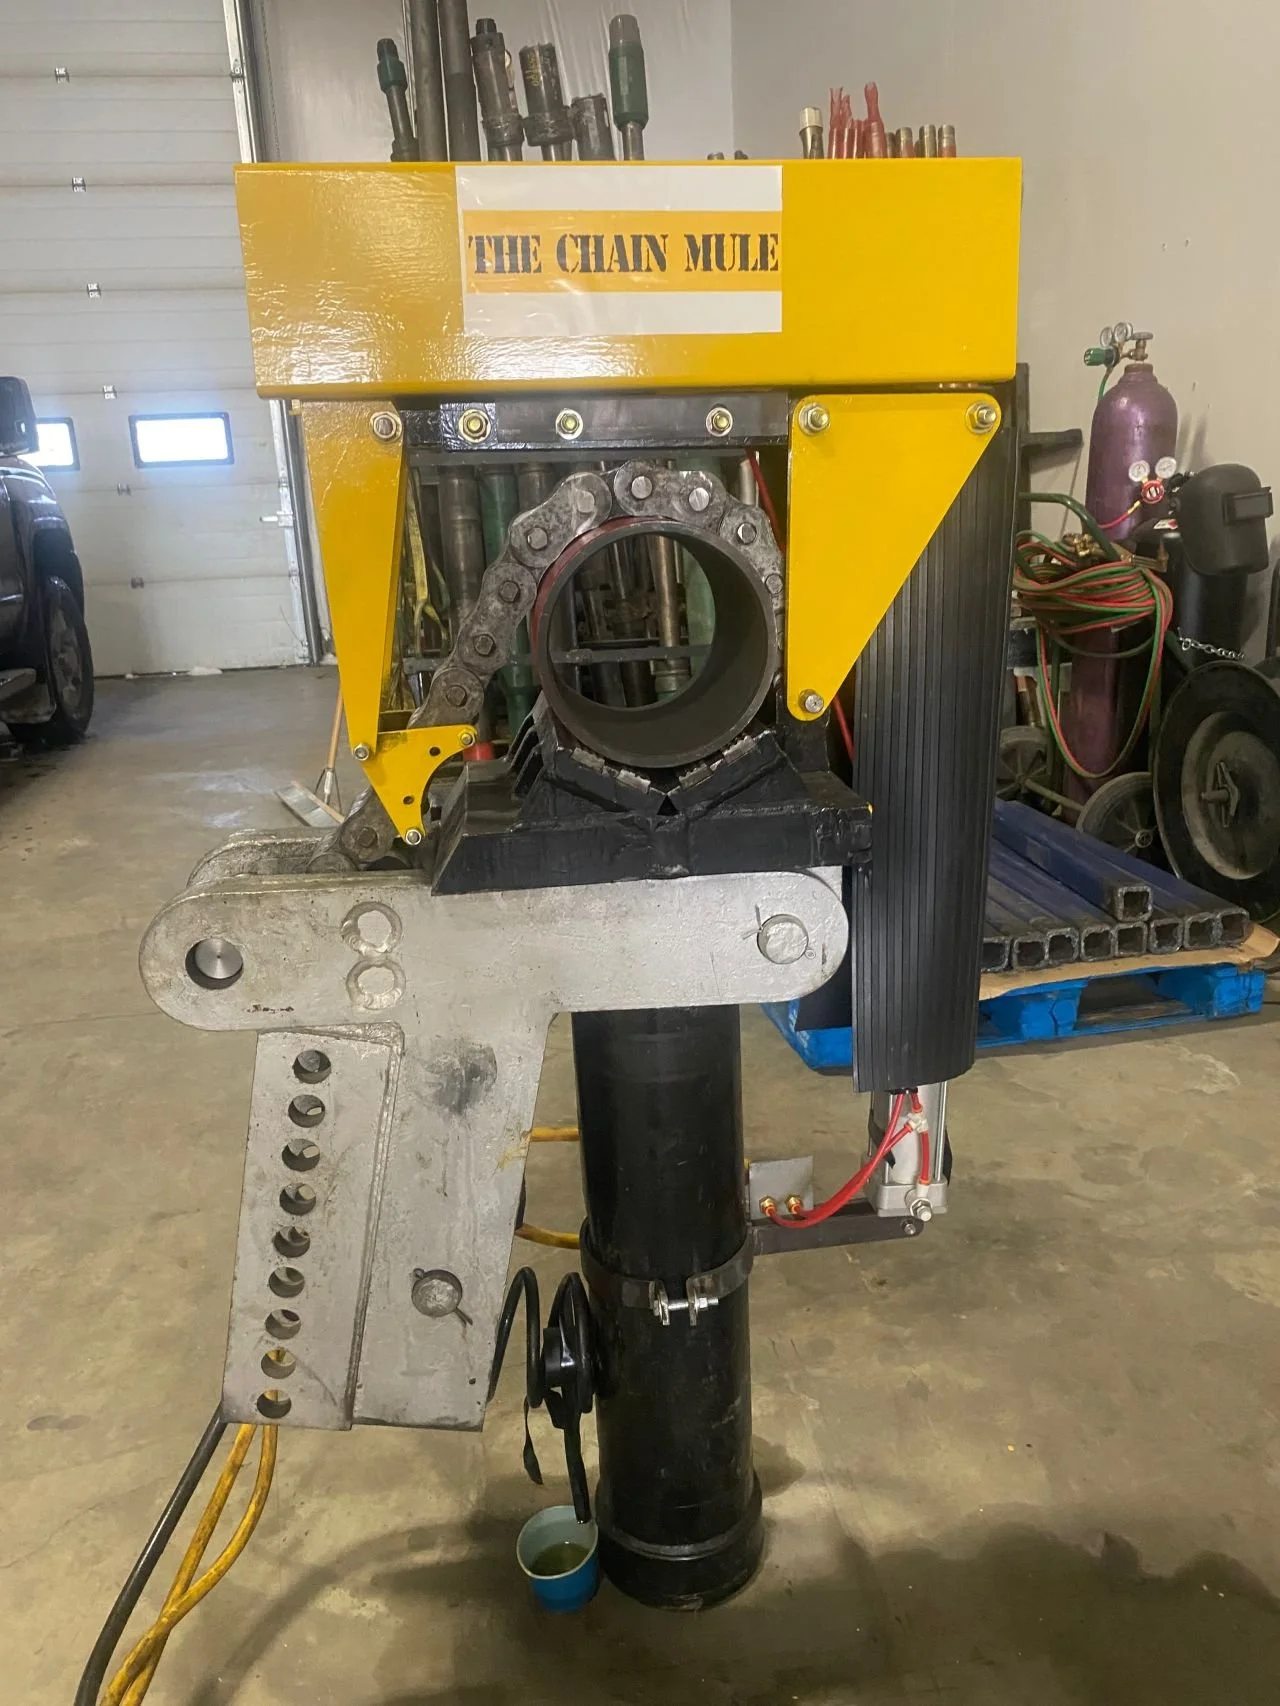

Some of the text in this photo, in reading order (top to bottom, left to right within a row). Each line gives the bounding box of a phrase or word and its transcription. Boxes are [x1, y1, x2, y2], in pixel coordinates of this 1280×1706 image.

[468, 233, 779, 274] THE CHAIN MULE
